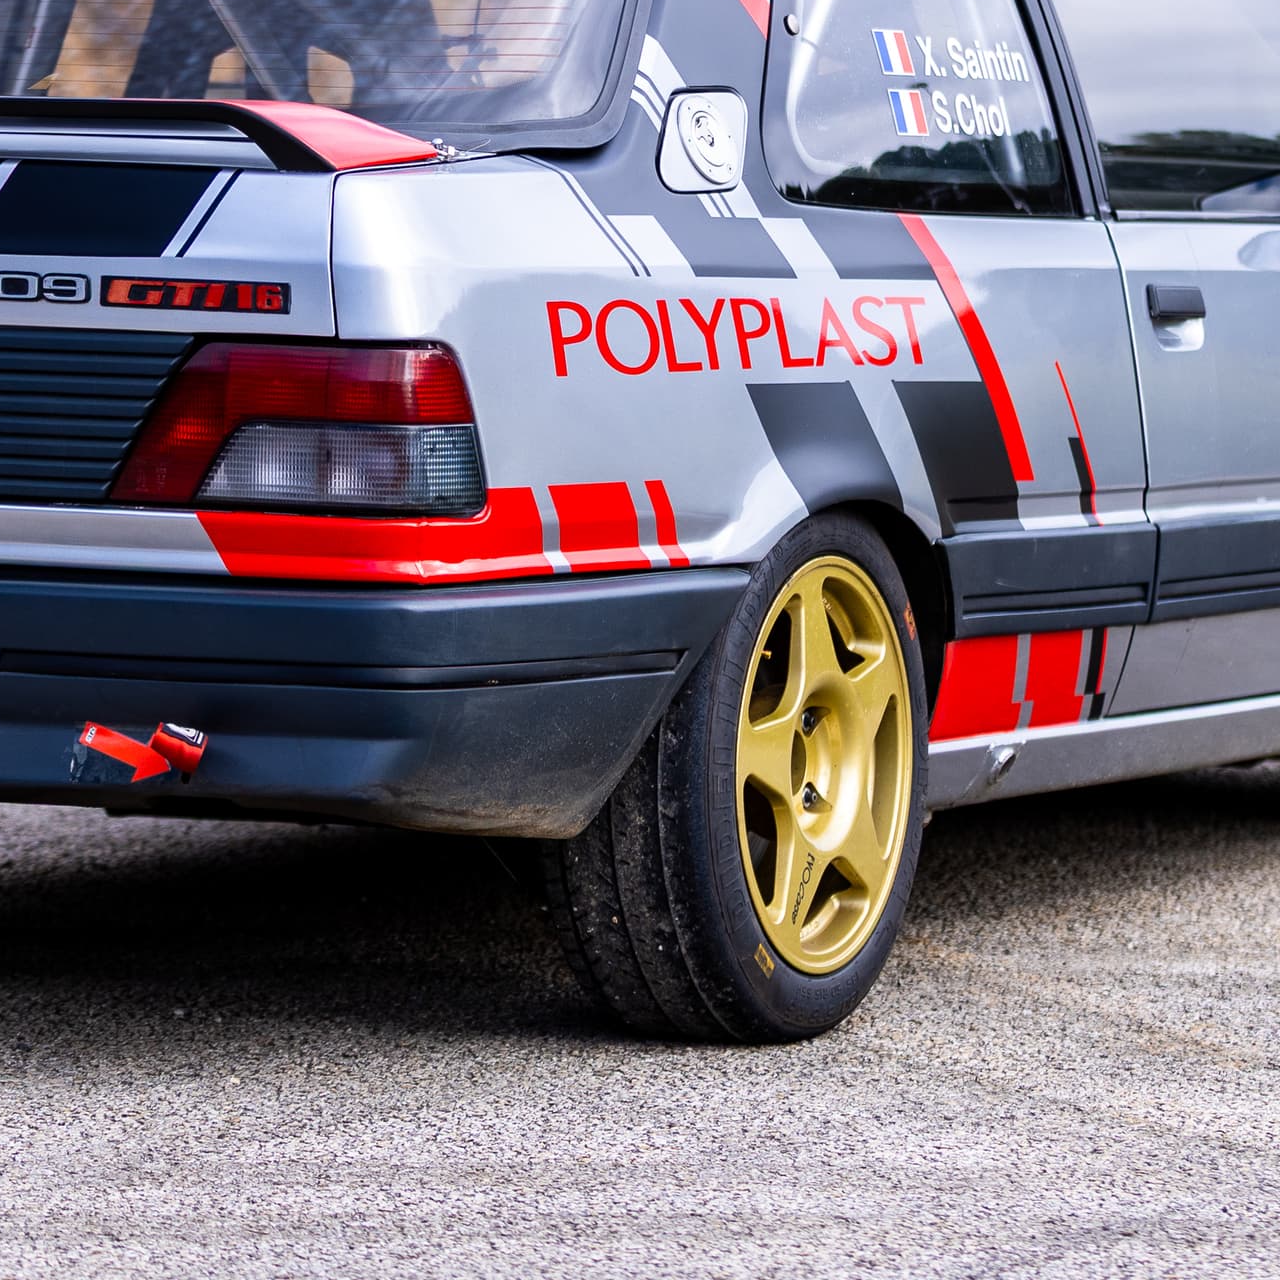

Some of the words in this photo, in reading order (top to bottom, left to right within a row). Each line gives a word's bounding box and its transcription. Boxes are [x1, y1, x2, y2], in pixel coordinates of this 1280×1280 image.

[915, 36, 947, 77] X.
[947, 37, 1030, 83] Saintin
[932, 90, 1012, 137] S.Chol
[546, 296, 925, 377] POLYPLAST
